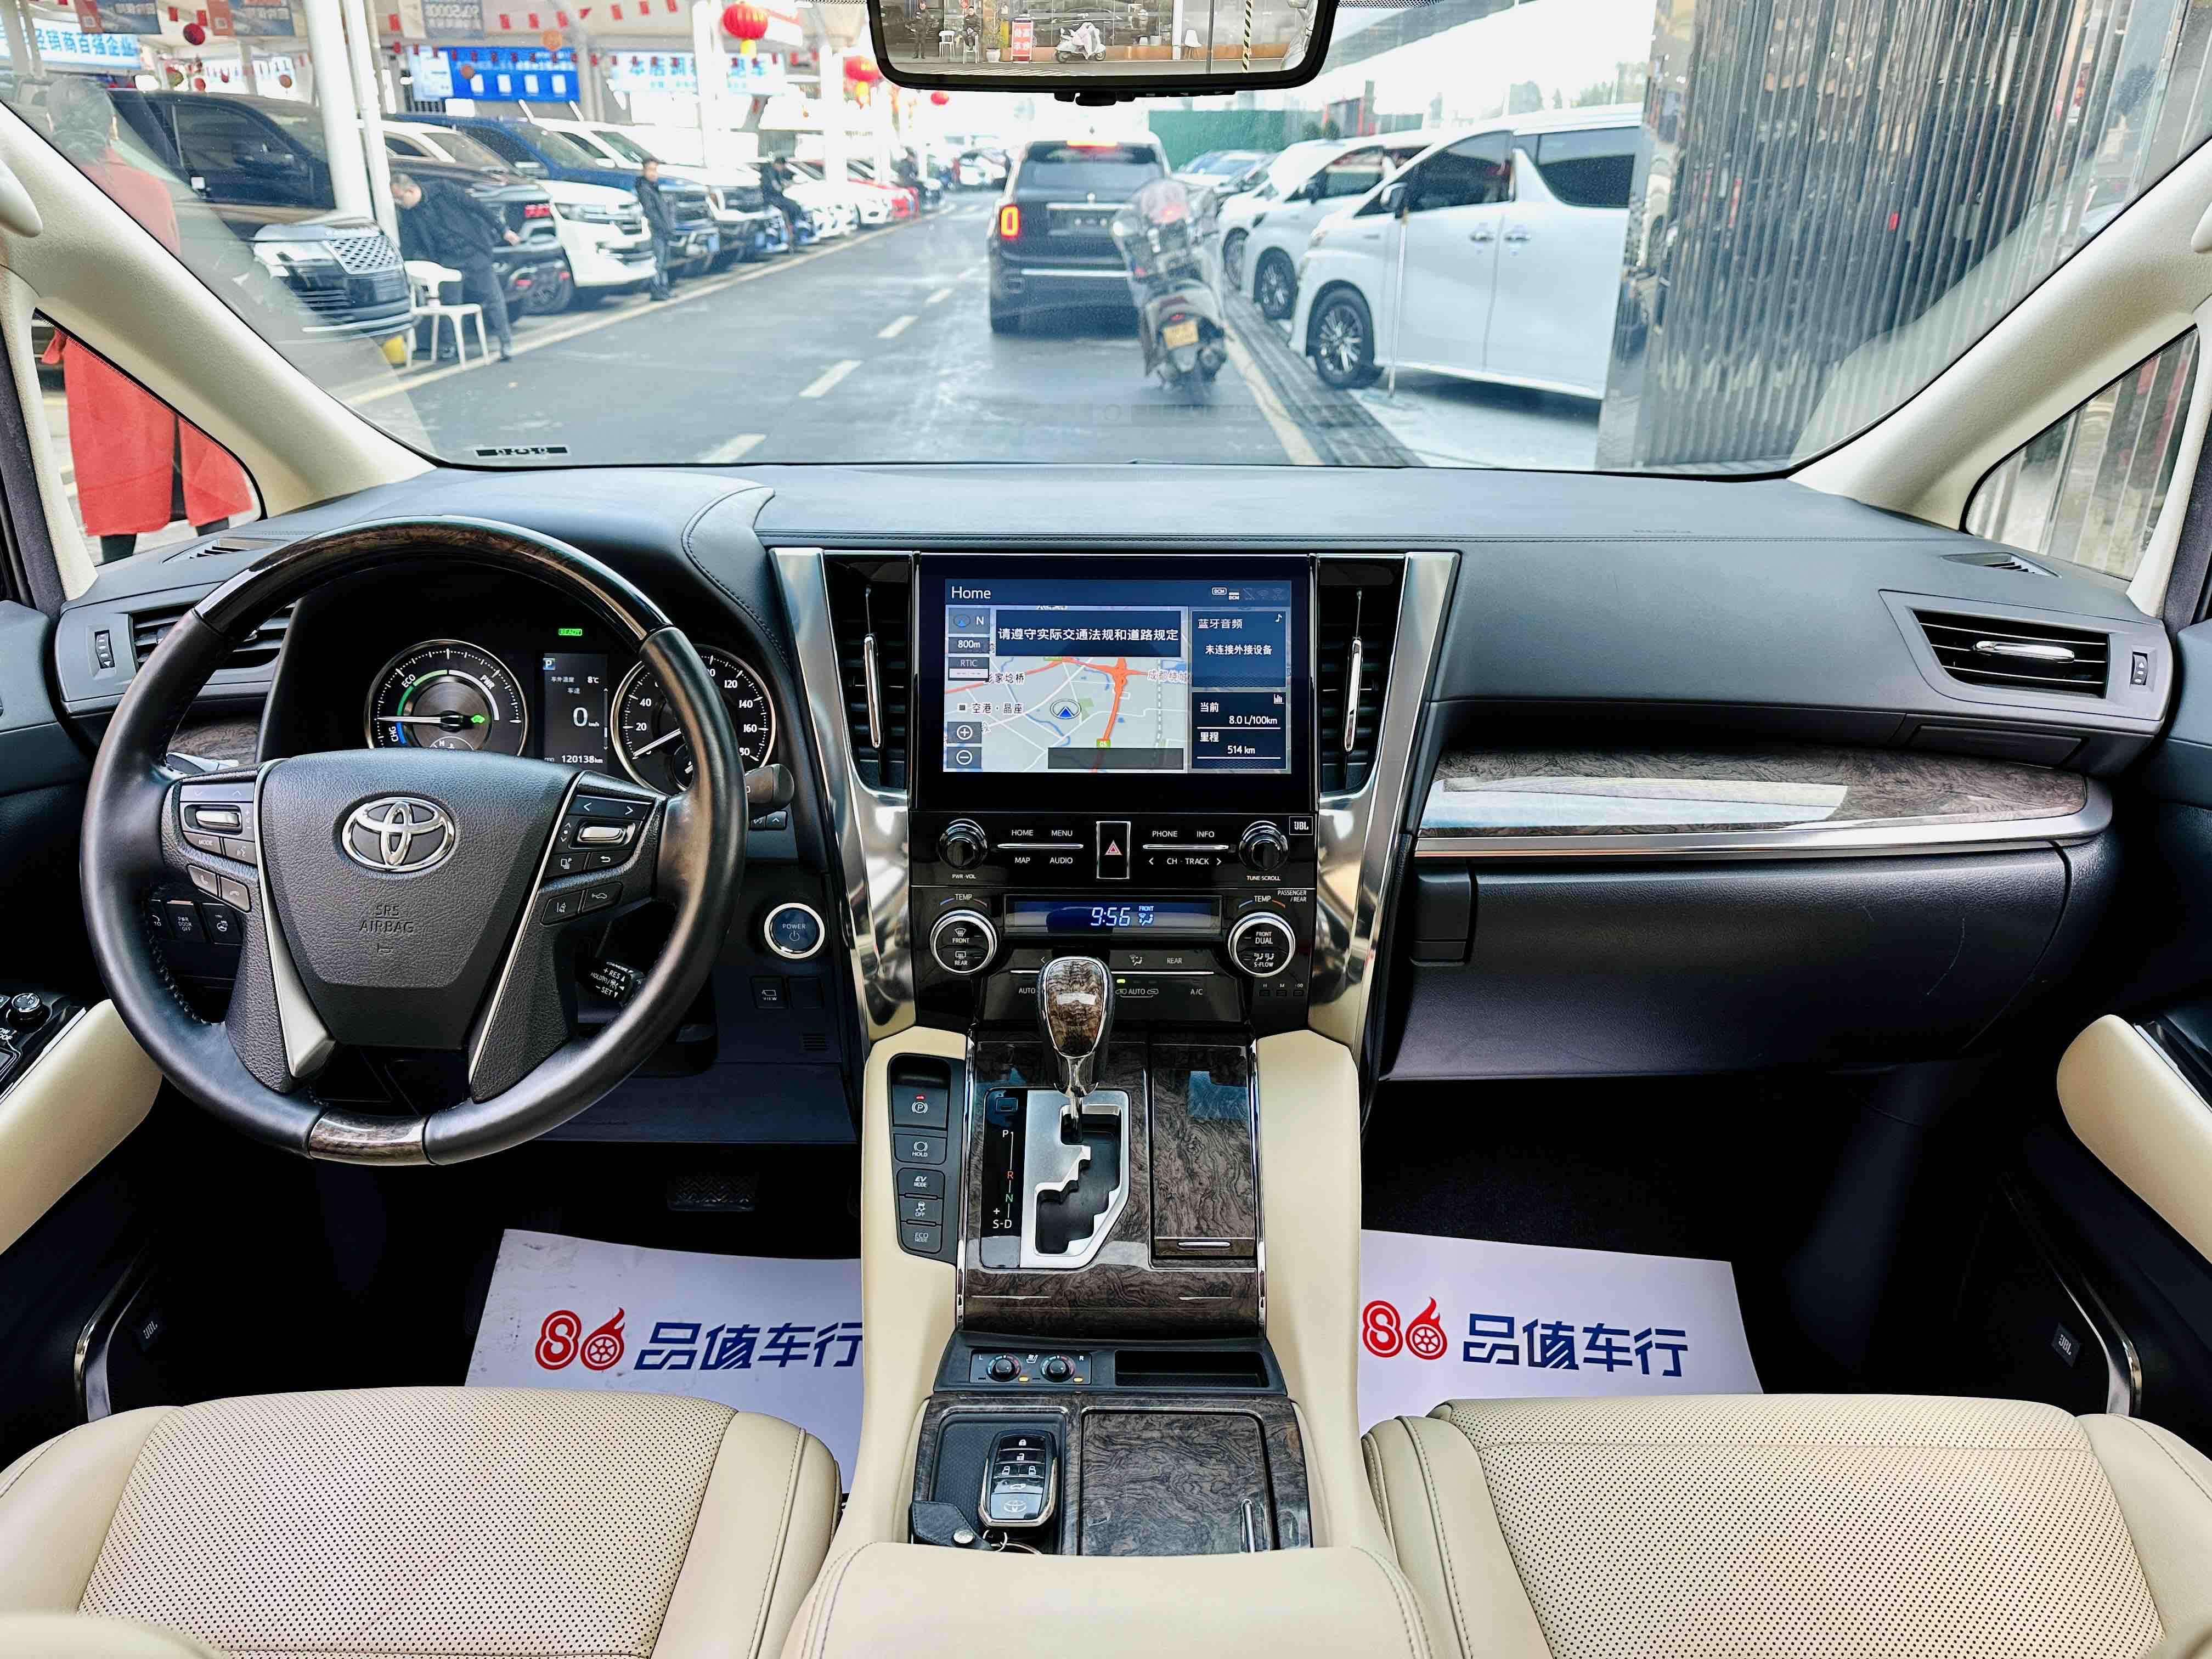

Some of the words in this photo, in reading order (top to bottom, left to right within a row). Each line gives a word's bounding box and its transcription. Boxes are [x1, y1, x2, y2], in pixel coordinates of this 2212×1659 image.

[951, 586, 991, 599] Home
[976, 616, 984, 625] N
[1198, 618, 1243, 629] 蓝牙音频
[998, 628, 1179, 641] 请遵守实际交通法规和道路规定
[957, 640, 980, 648] 800m
[1205, 644, 1273, 655] 未连接外接设备
[545, 659, 553, 669] P
[960, 659, 978, 667] RTIC
[401, 674, 416, 689] ECO
[479, 675, 495, 690] PWR
[724, 680, 738, 689] 120
[640, 698, 652, 707] 40
[739, 699, 753, 708] 140
[1200, 702, 1220, 713] 当前
[573, 707, 588, 727] 0
[1228, 715, 1243, 724] 8.0
[1244, 715, 1278, 725] L/100km
[635, 723, 647, 731] 20
[743, 724, 758, 732] 160
[388, 726, 398, 742] CHG
[1199, 731, 1220, 742] 里程
[1227, 745, 1243, 754] 514
[1244, 746, 1256, 754] km
[373, 905, 400, 916] SRS
[1090, 907, 1131, 927] 9:56
[359, 919, 414, 933] AIRBAG
[608, 969, 621, 979] RES
[601, 986, 613, 996] SET
[1002, 1129, 1009, 1138] P
[1007, 1170, 1014, 1180] R
[1005, 1194, 1013, 1203] N
[143, 1321, 158, 1339] JBL
[2058, 1334, 2072, 1356] JBL
